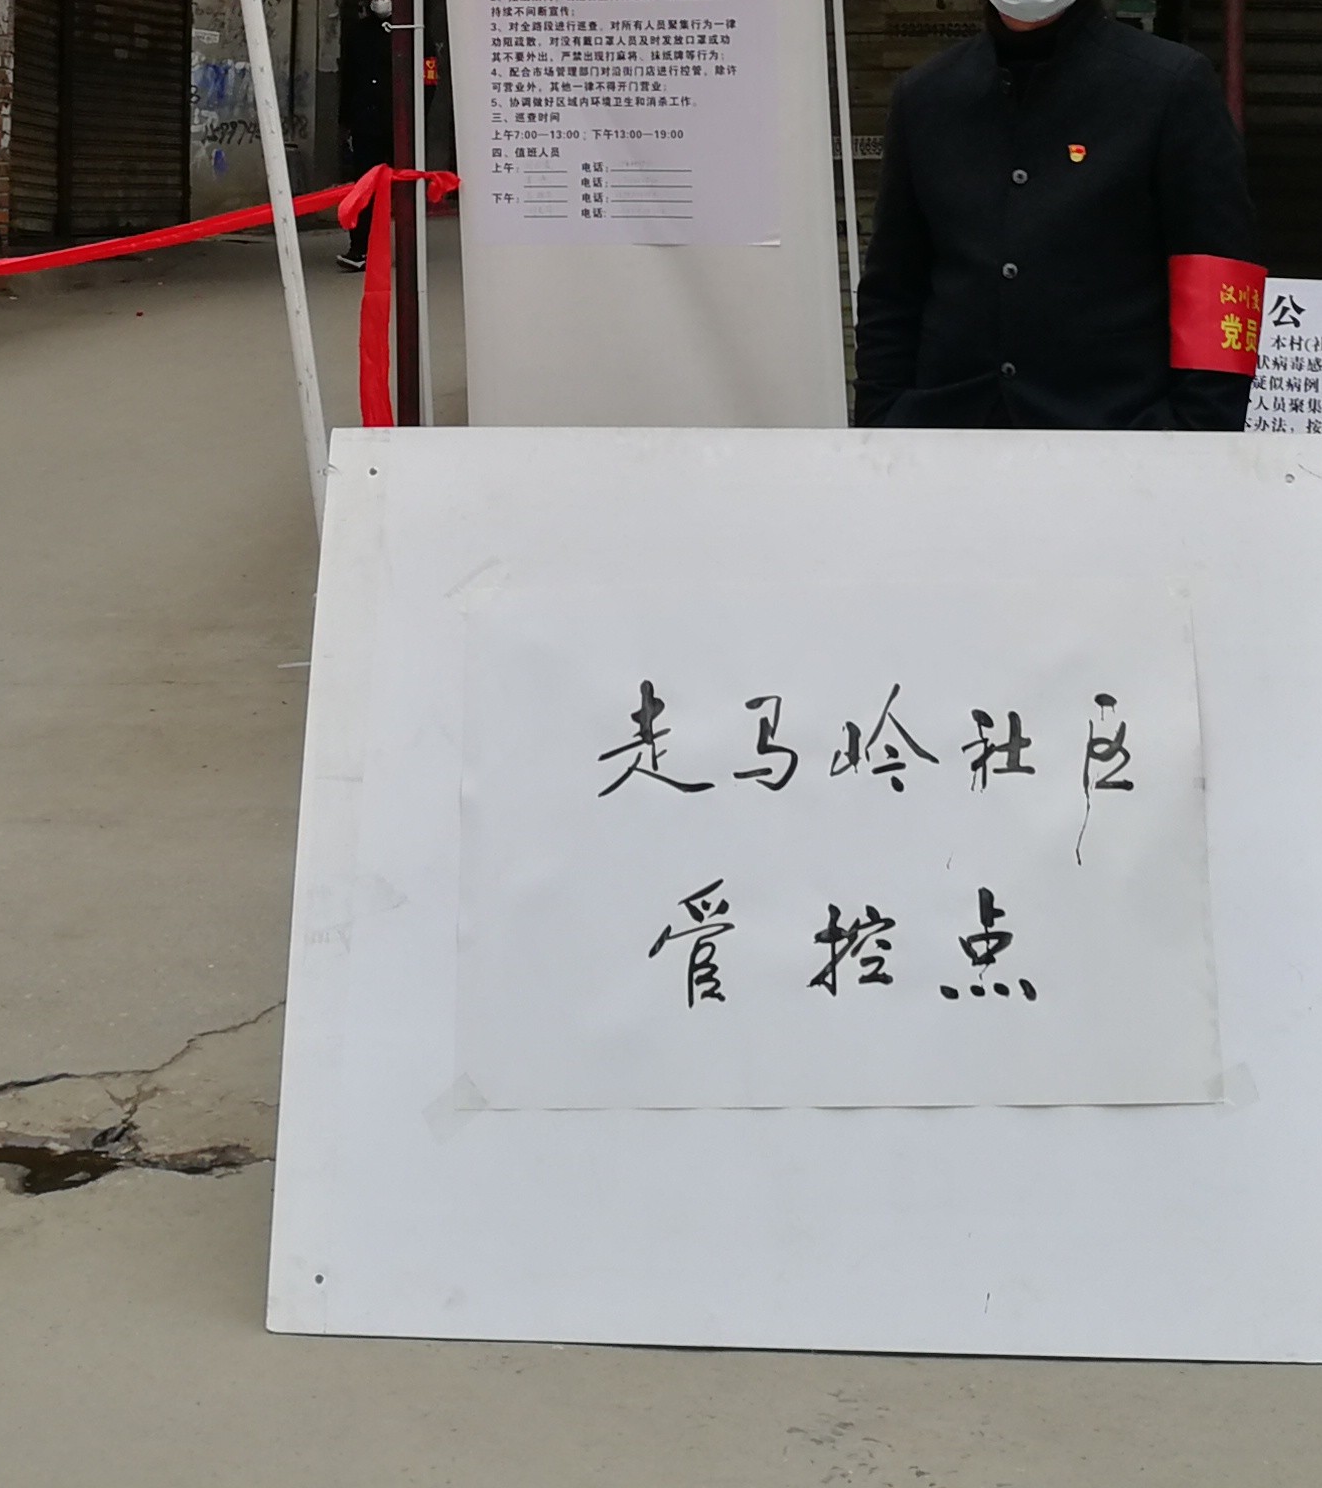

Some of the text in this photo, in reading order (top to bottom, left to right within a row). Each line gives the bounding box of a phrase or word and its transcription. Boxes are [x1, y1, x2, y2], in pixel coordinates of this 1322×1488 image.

[598, 680, 1134, 802] 走马岭社区
[649, 878, 1038, 1008] 管控点
